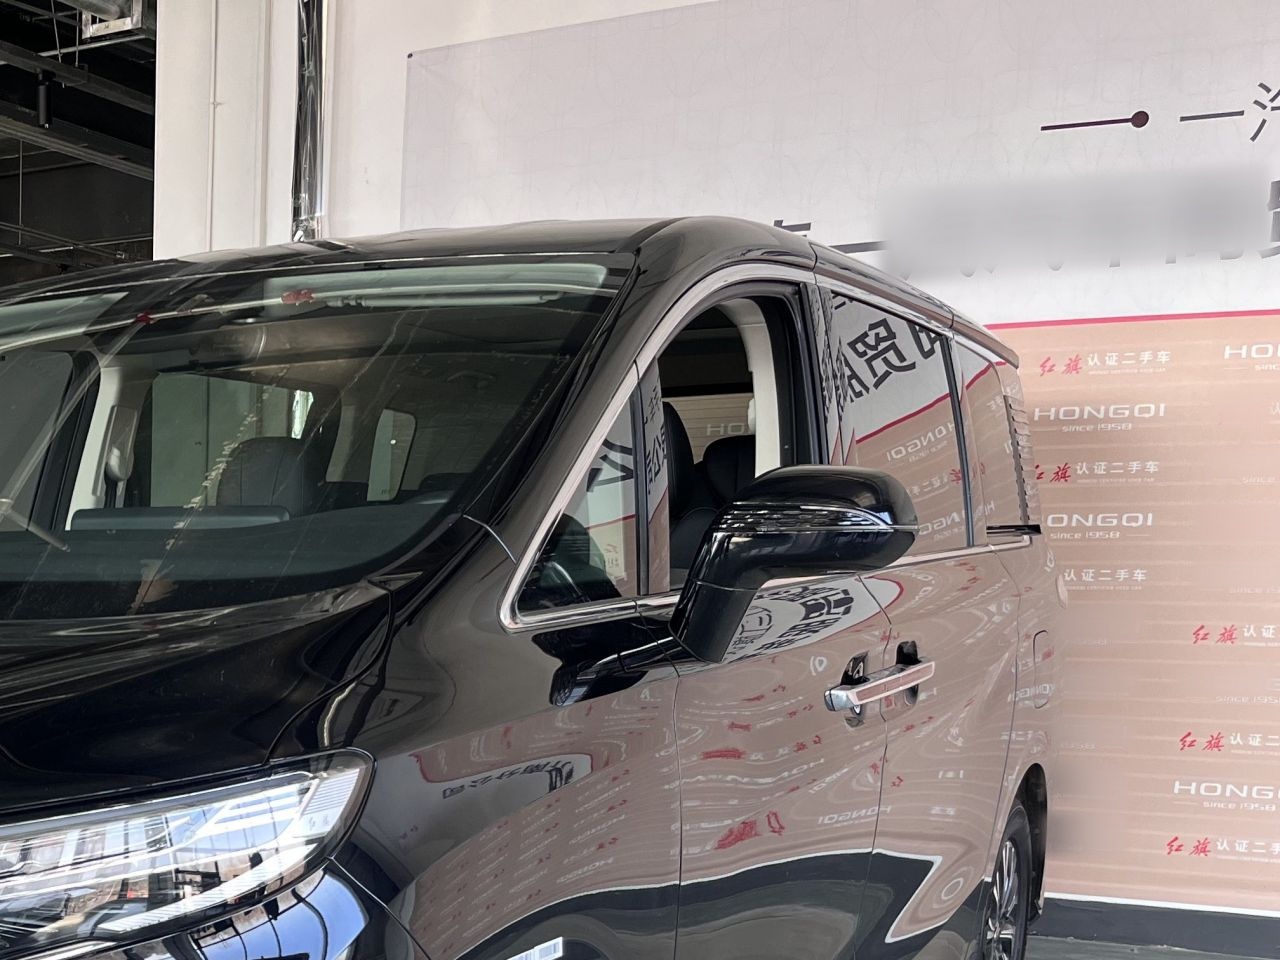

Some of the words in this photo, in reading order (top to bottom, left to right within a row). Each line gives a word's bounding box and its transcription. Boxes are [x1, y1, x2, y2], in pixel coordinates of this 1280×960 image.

[1224, 344, 1280, 360] HO
[1039, 353, 1083, 377] 红旗
[1087, 351, 1171, 366] 认证二手车
[1033, 403, 1166, 421] HONGQI
[1062, 424, 1095, 433] since
[1098, 422, 1132, 432] 1958
[1076, 461, 1160, 475] 认证二手车
[1046, 512, 1153, 528] ONGQI
[1050, 531, 1081, 540] since
[1085, 530, 1120, 539] 1958
[1063, 568, 1147, 582] 认证二手车
[1192, 624, 1238, 645] 红旗
[1179, 731, 1224, 751] 红旗
[1173, 780, 1280, 799] HONG
[1202, 801, 1236, 810] since
[1240, 801, 1276, 812] 1958
[1166, 836, 1211, 857] 红旗
